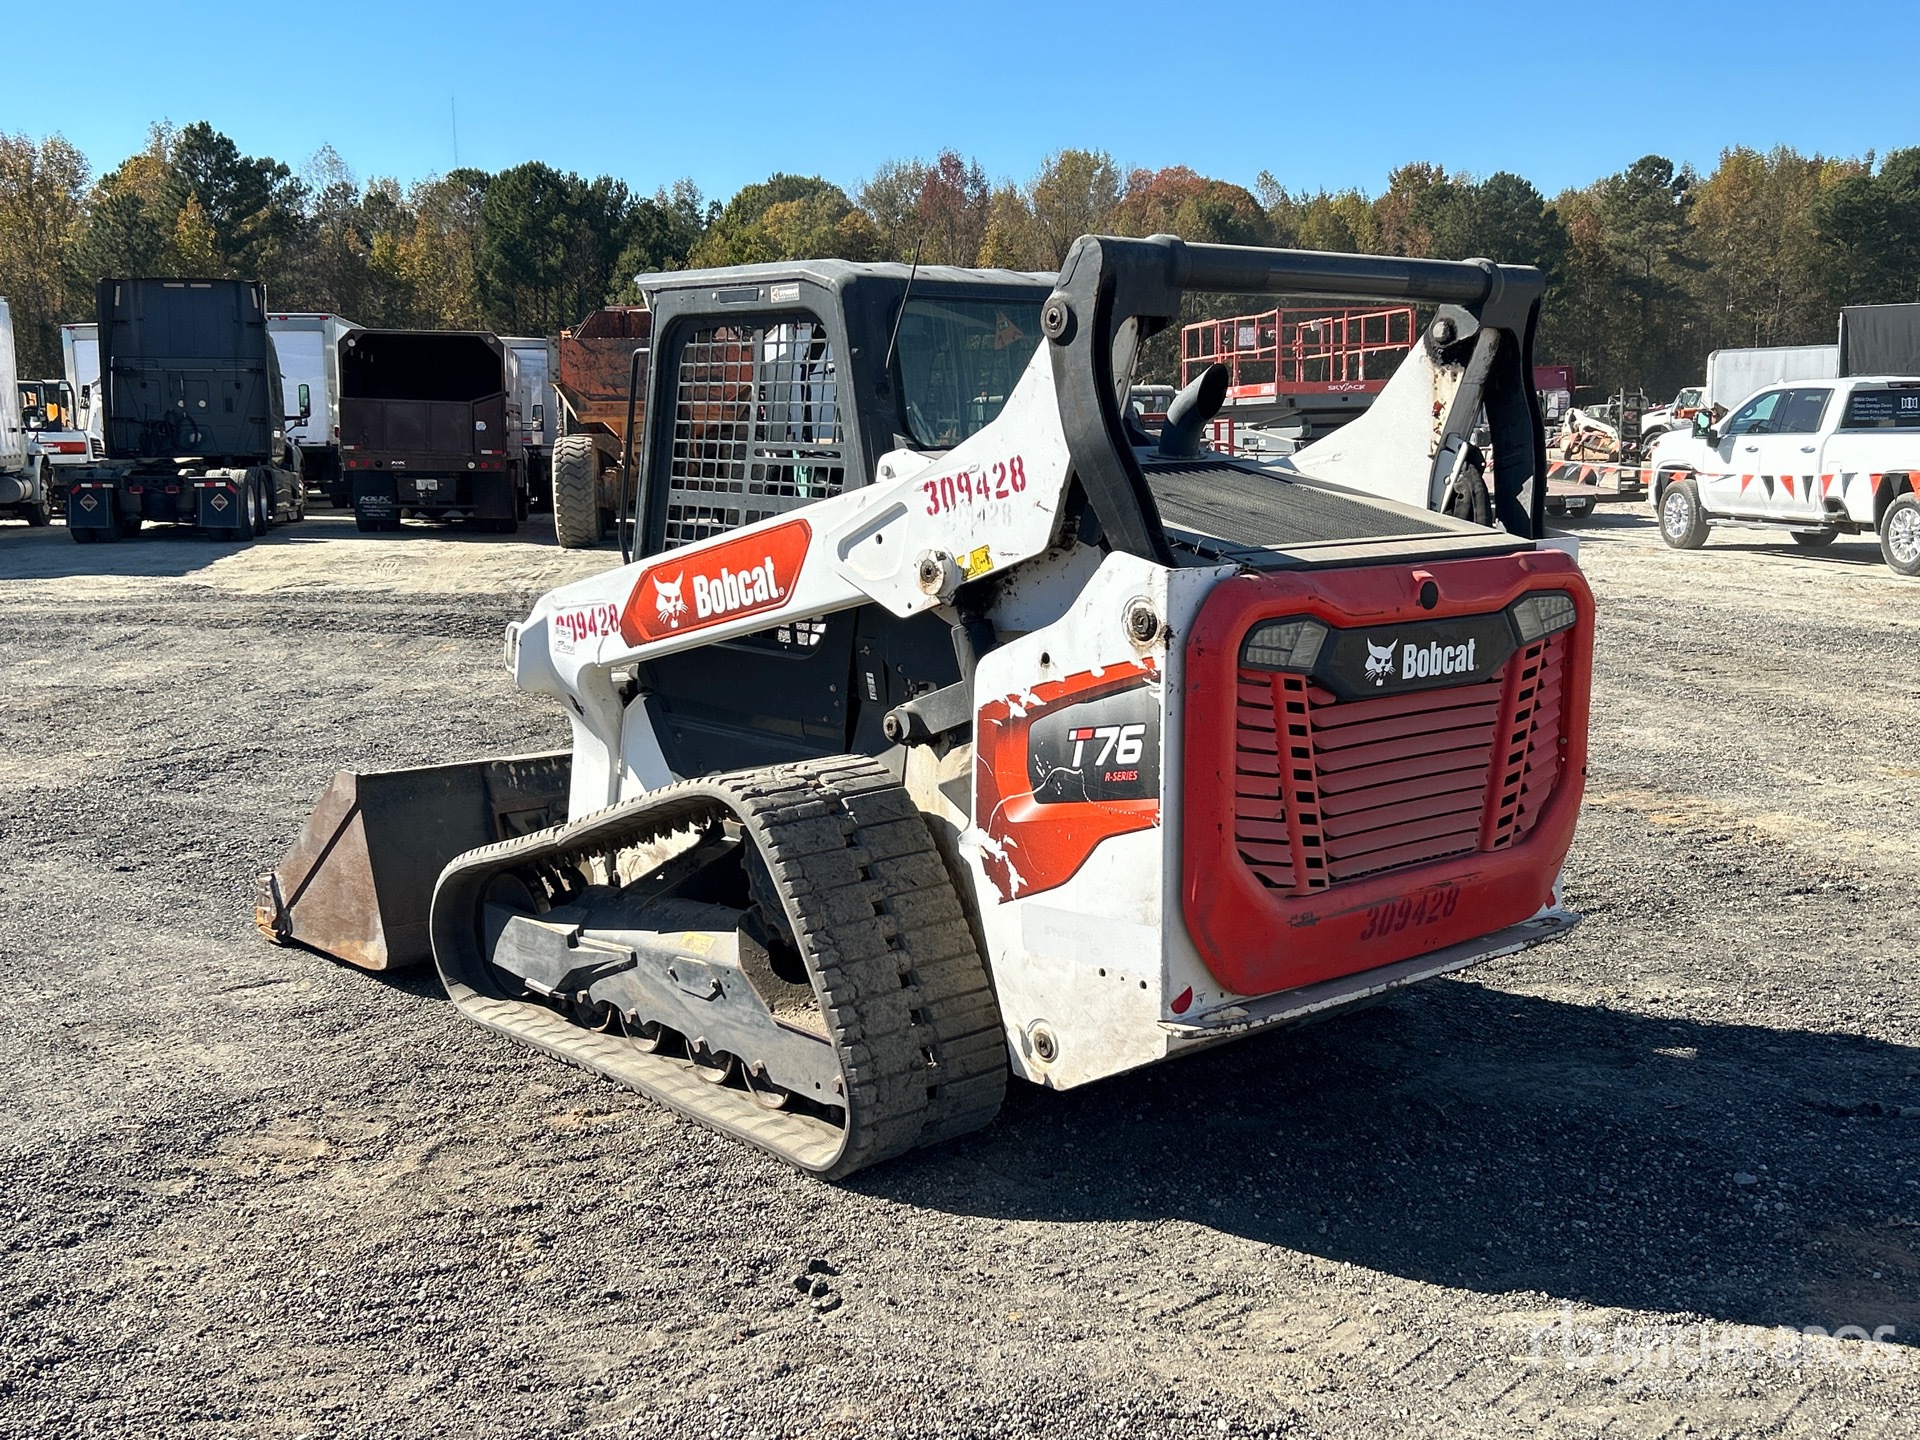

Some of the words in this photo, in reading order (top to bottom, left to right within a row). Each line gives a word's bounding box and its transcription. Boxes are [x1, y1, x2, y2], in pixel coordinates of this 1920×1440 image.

[1328, 382, 1365, 391] SKYJACK
[924, 455, 1026, 515] 309428
[692, 556, 779, 618] Bobcat
[1402, 638, 1476, 679] Bobcat
[1068, 723, 1146, 767] T76
[1104, 771, 1138, 782] R-SERIES
[1360, 883, 1460, 941] 309428
